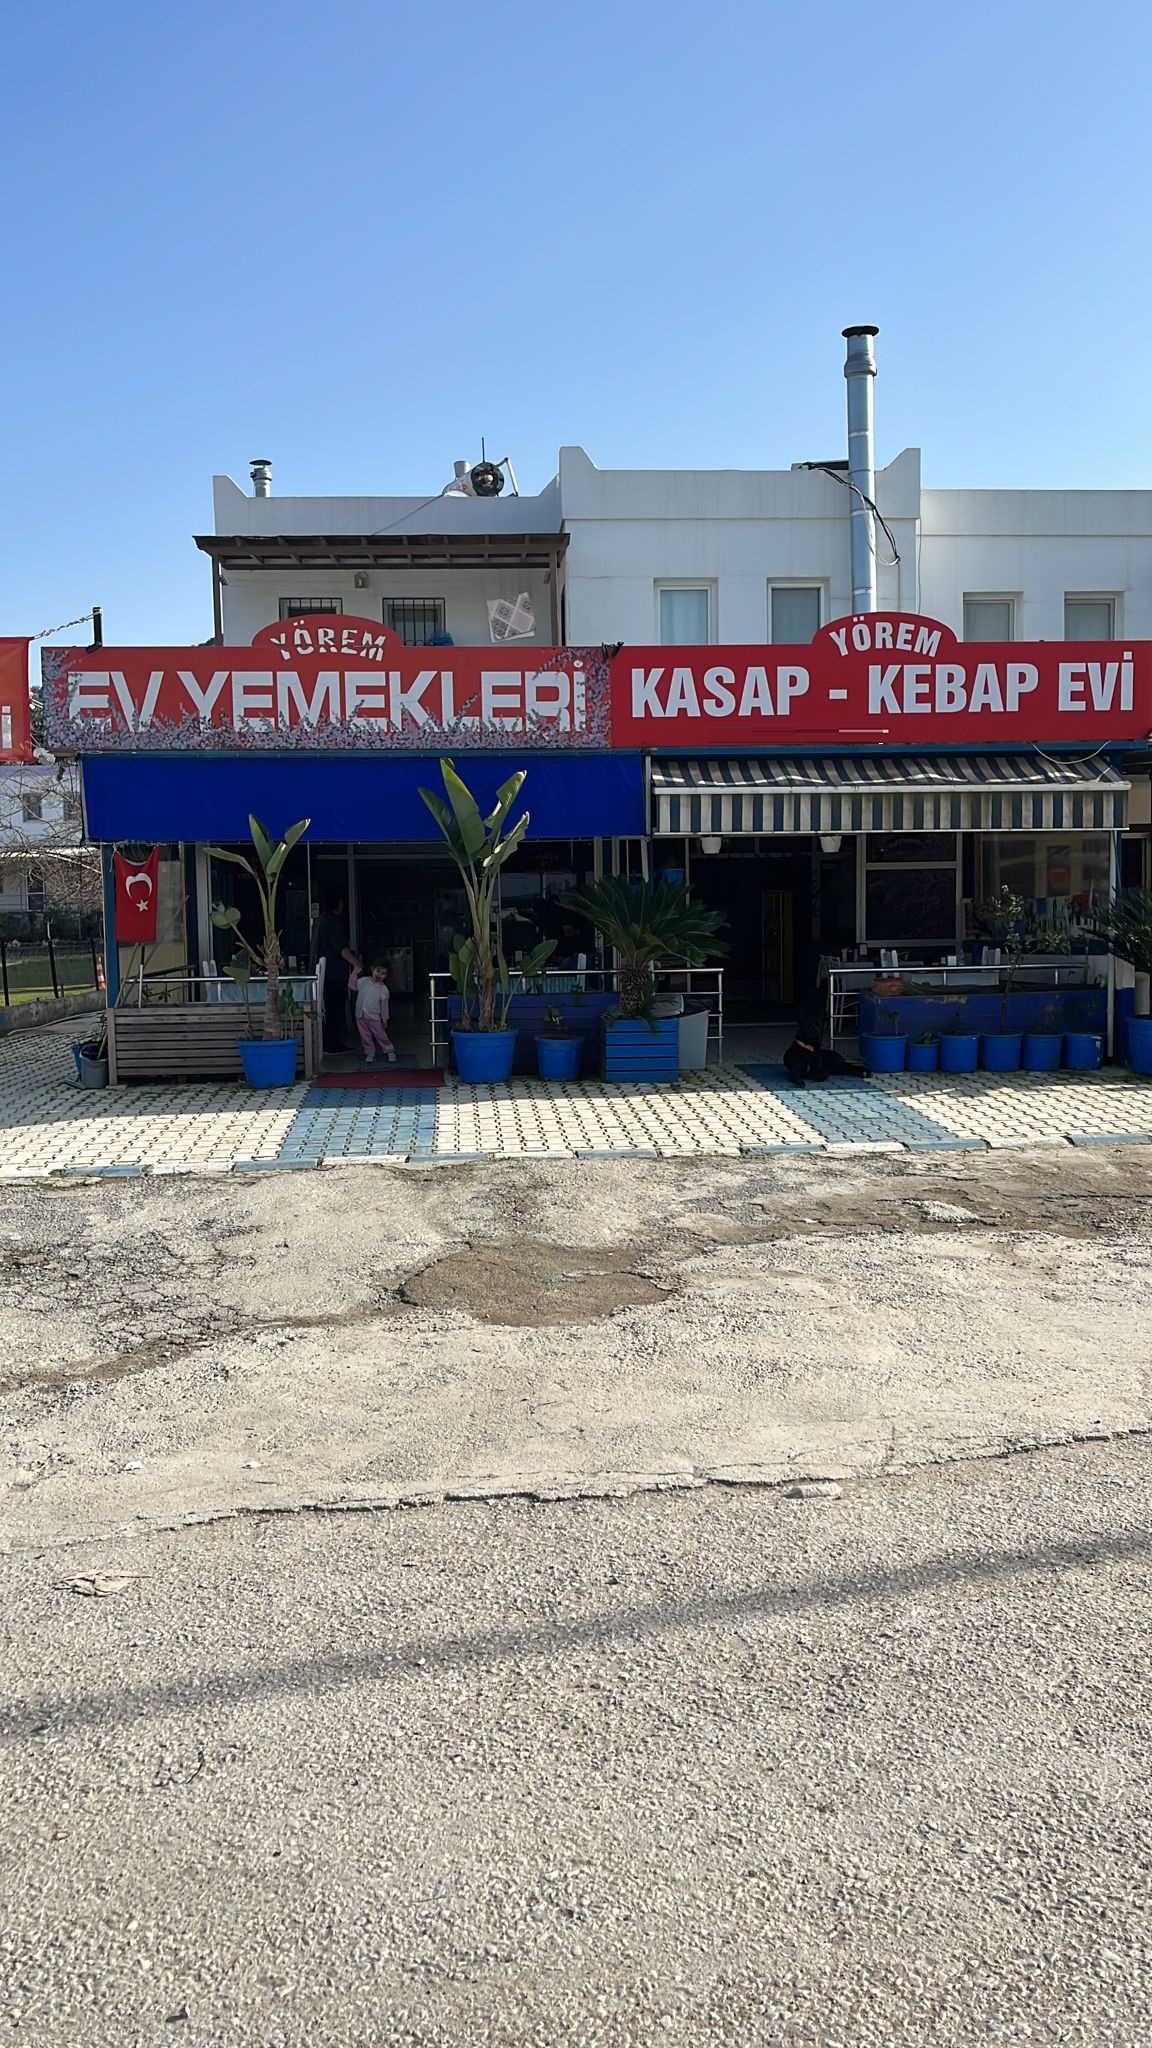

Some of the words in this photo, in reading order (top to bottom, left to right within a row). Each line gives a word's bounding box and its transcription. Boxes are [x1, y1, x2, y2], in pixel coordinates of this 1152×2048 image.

[270, 620, 388, 662] YÖREM
[828, 615, 943, 659] YÖREM
[66, 671, 163, 733] EV
[175, 659, 589, 733] YEMEKLERİ
[631, 666, 811, 719] KASAP
[828, 689, 849, 700] -
[867, 662, 1040, 715] KEBAP
[1057, 651, 1135, 712] EVİ
